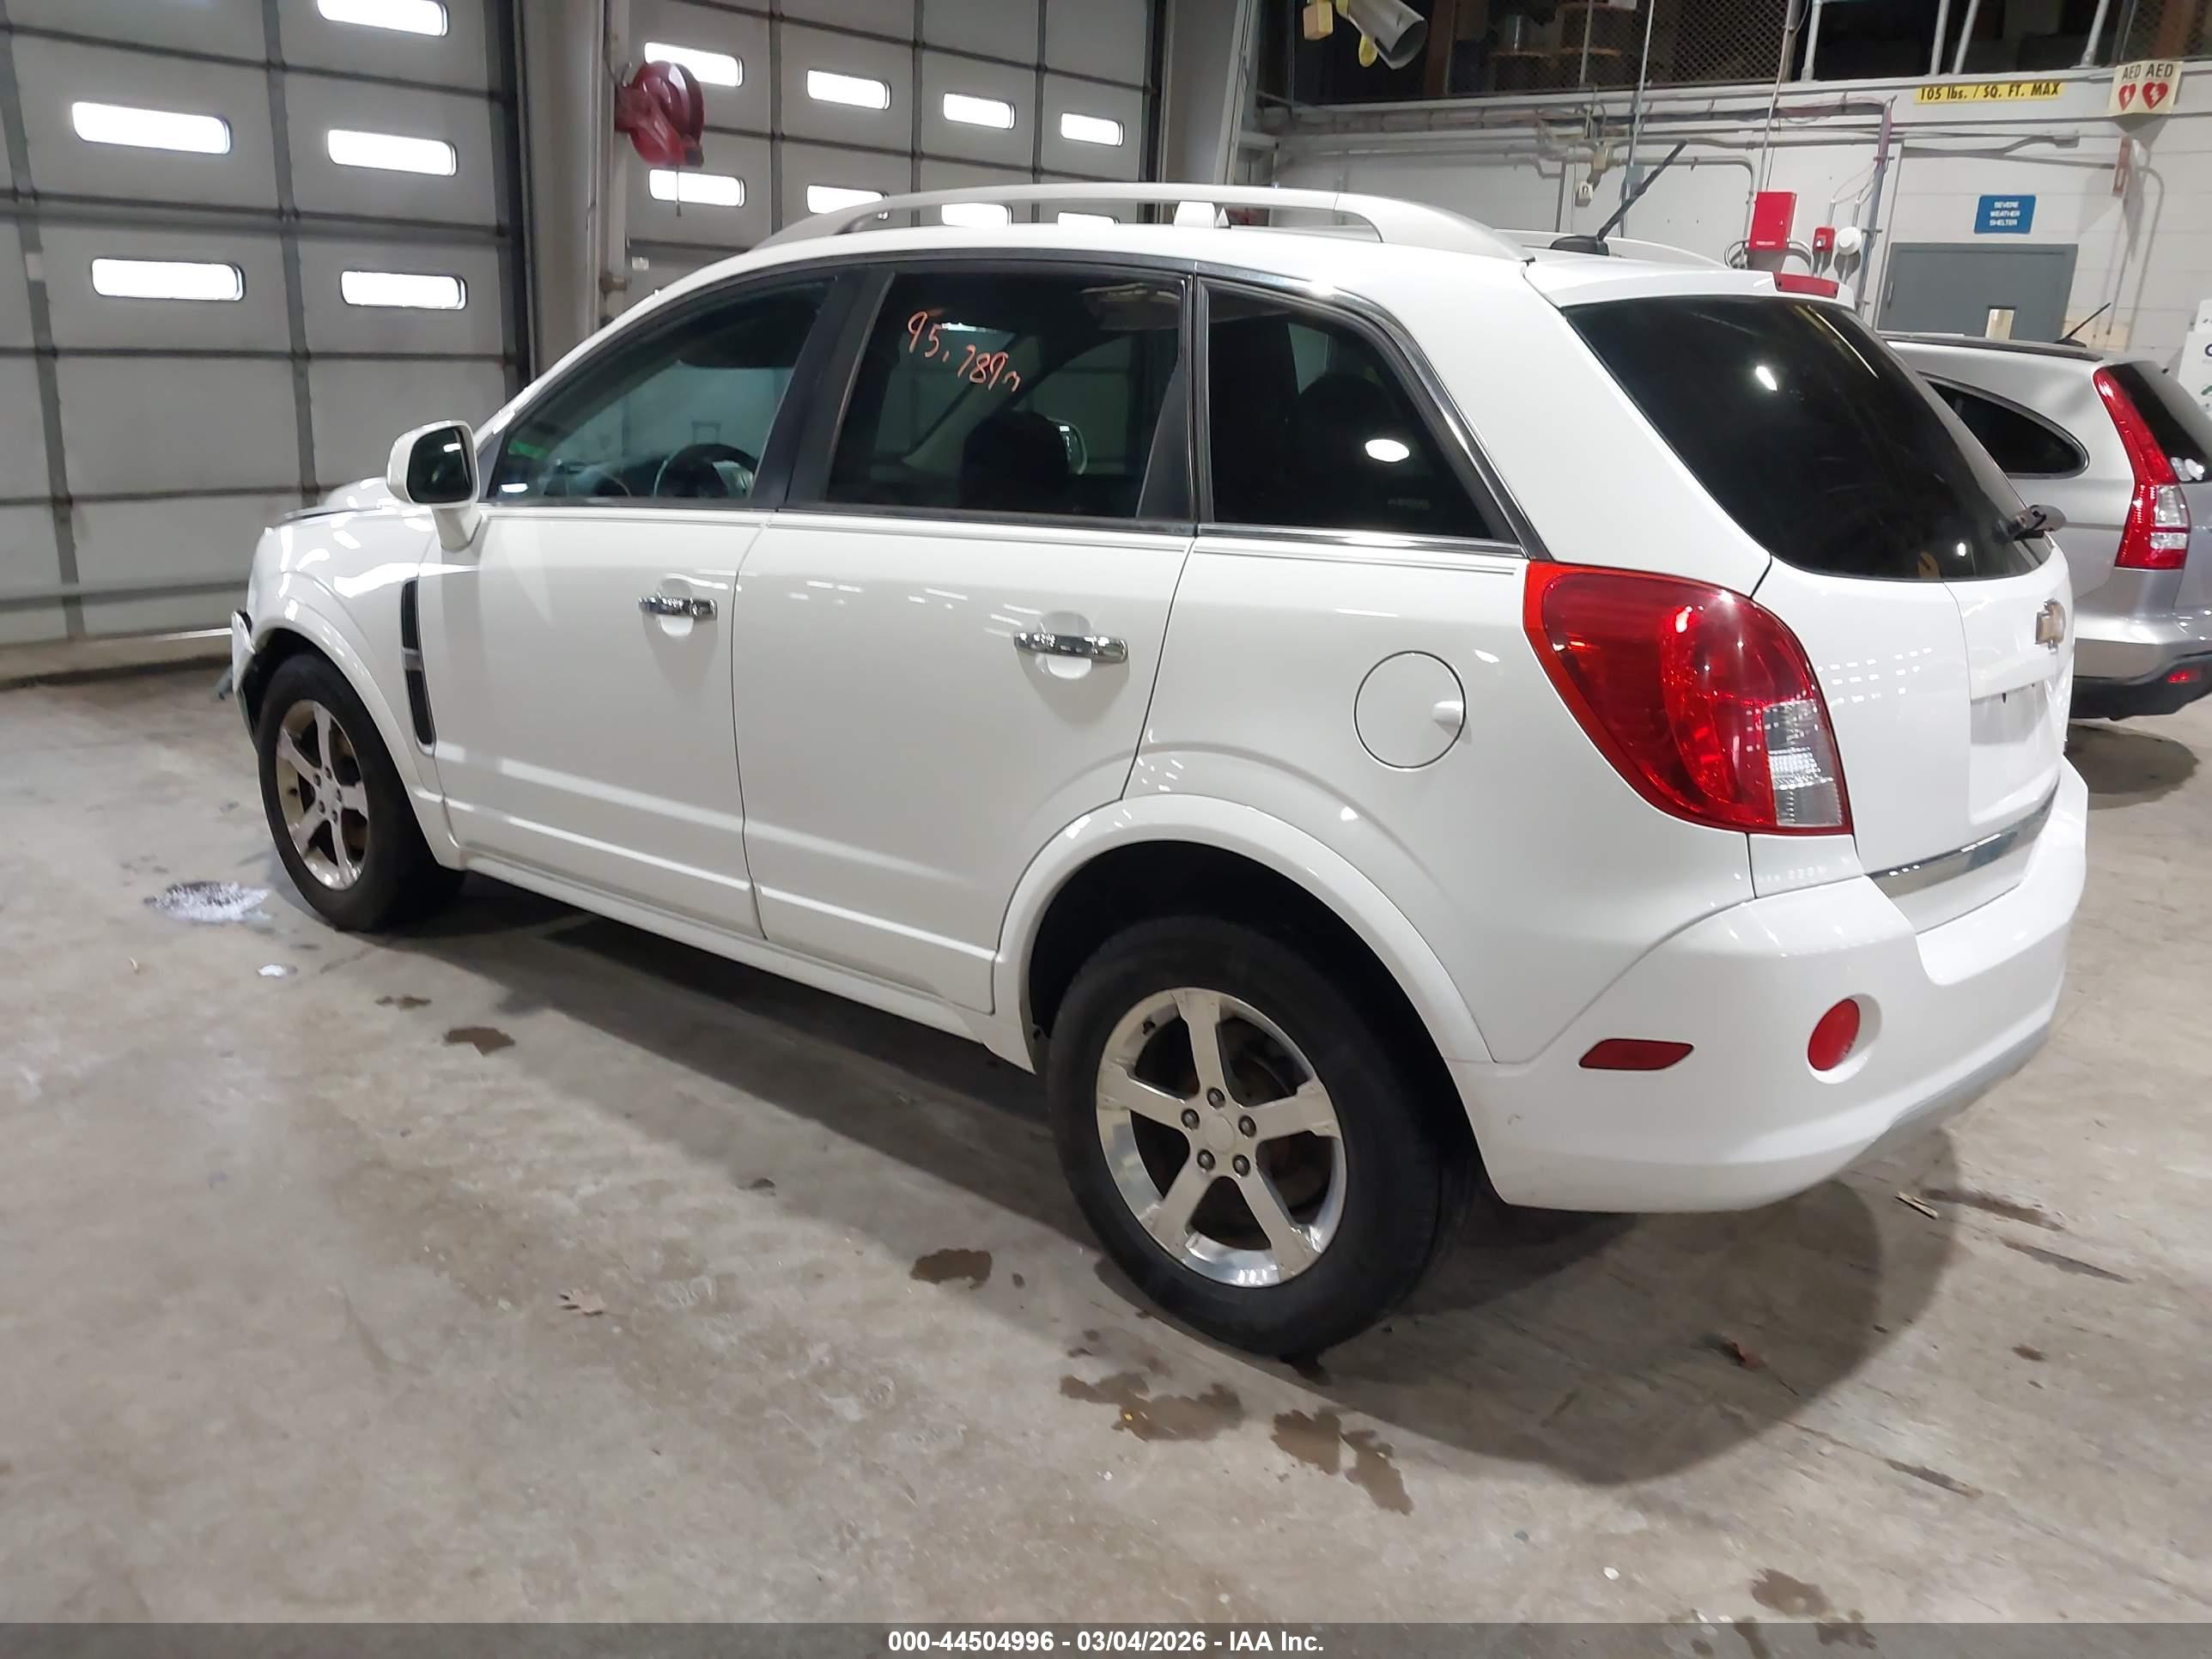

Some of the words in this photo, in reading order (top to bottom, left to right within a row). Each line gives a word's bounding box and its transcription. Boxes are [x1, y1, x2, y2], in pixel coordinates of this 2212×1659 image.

[2122, 64, 2142, 81] AED
[2146, 64, 2173, 77] AED
[1921, 87, 1942, 100] 105
[1947, 86, 1967, 100] lbs.
[1973, 85, 1980, 99] /
[1984, 85, 2002, 99] SQ.
[2008, 84, 2025, 97] FT.
[2030, 82, 2061, 97] MAX
